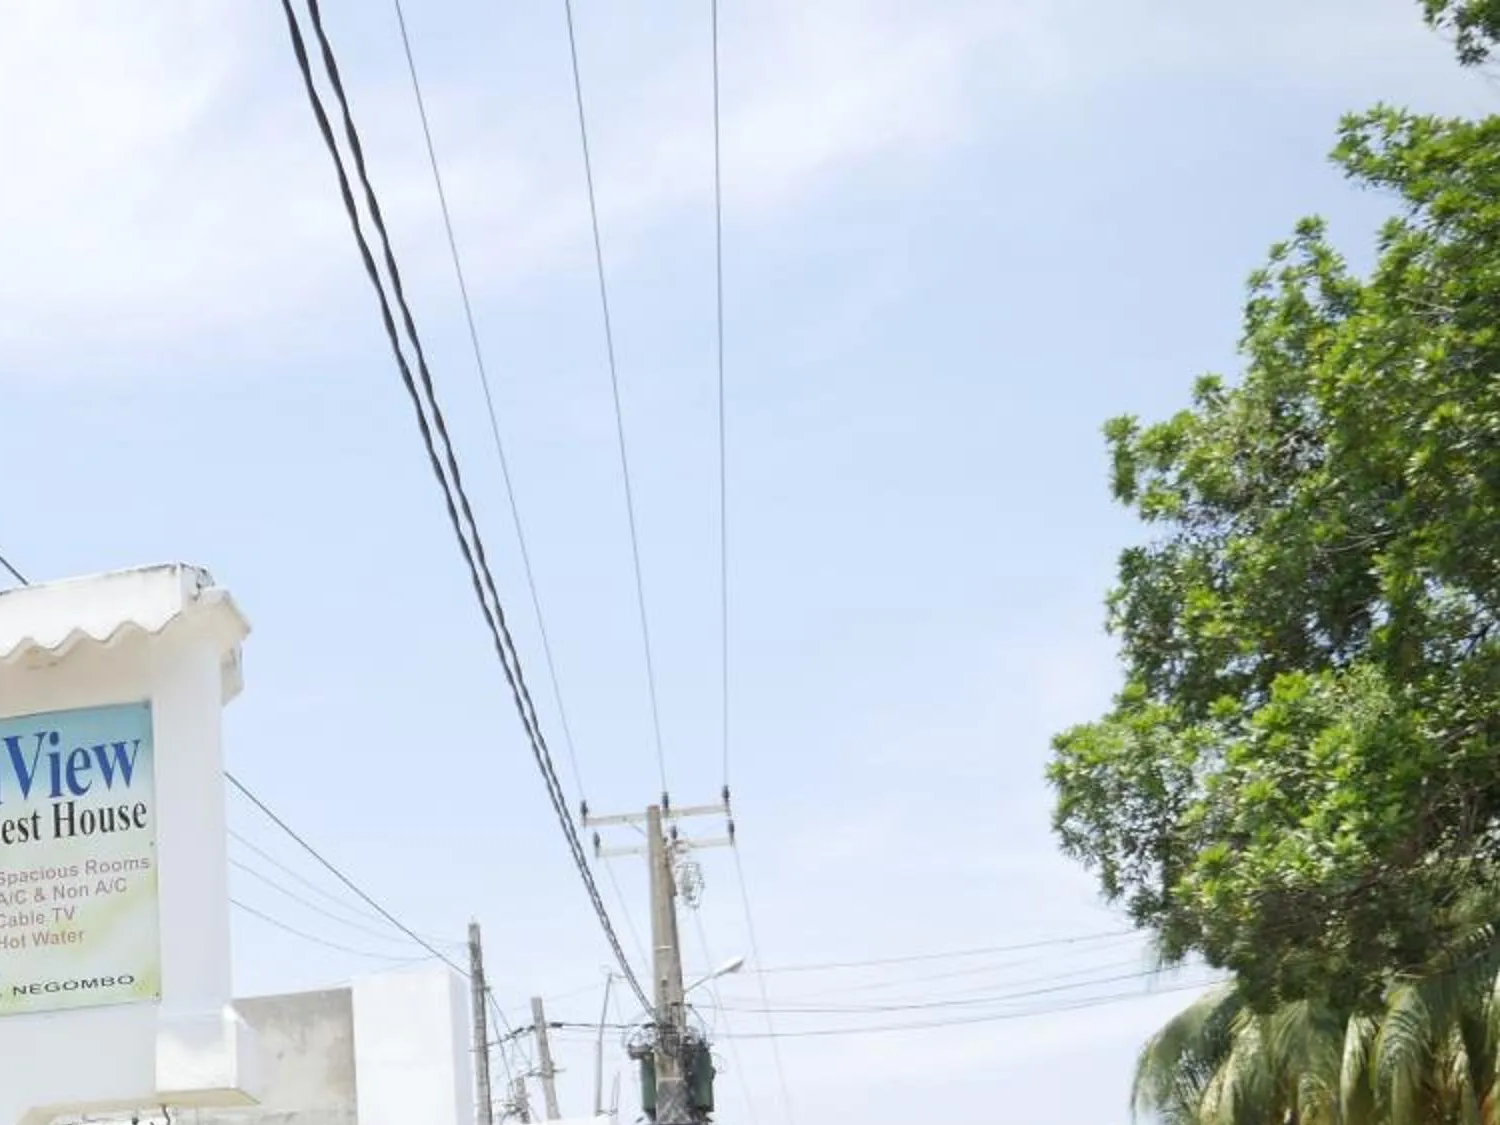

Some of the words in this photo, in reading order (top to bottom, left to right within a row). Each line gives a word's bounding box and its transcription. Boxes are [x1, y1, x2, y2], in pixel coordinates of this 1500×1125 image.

[3, 731, 141, 800] View
[52, 801, 147, 838] House
[85, 857, 151, 876] Rooms
[33, 887, 46, 903] &
[52, 884, 89, 901] Non
[95, 877, 128, 895] A/C
[52, 905, 76, 923] TV
[32, 929, 85, 947] Water
[12, 974, 136, 997] NEGOMBO
